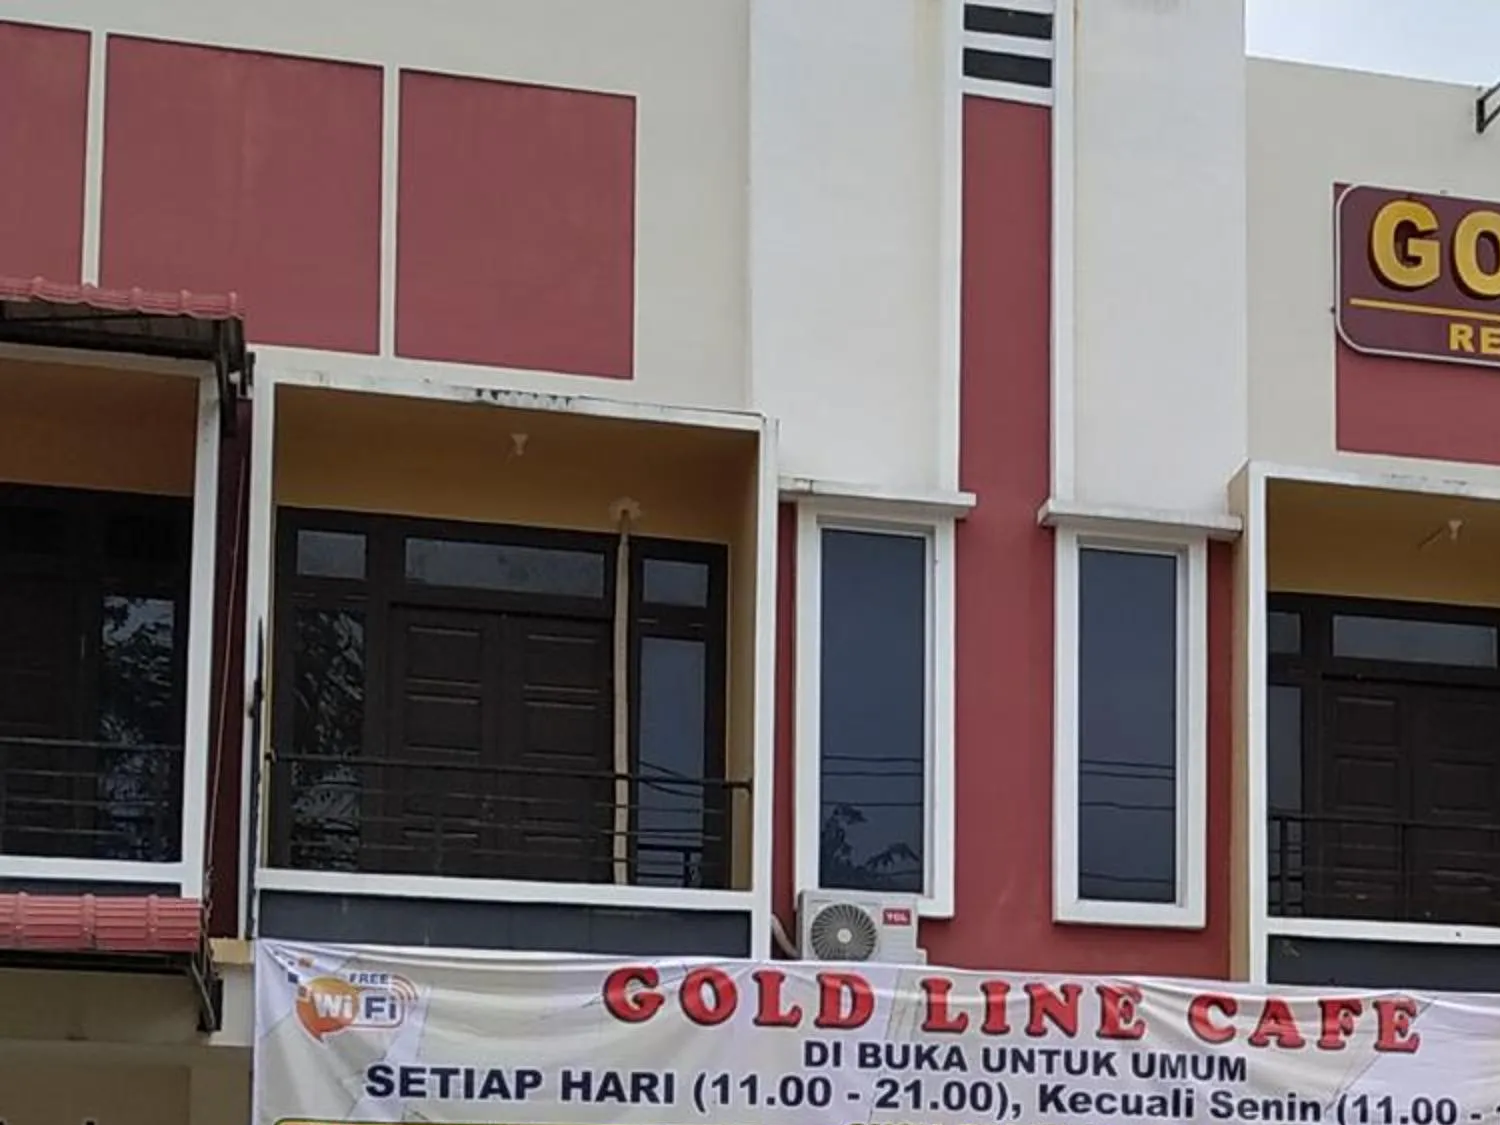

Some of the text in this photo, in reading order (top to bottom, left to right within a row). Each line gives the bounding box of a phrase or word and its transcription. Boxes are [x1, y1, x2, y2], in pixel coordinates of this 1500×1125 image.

[349, 972, 388, 984] FREE
[602, 966, 1421, 1054] GOLD LINE CAFE
[805, 1041, 1247, 1082] DI BUKA UNTUK UMUM
[366, 1064, 542, 1100] SETIAP
[561, 1070, 675, 1105] HARI
[693, 1072, 832, 1113] (11.00
[874, 1077, 1022, 1120] 21.00),
[1038, 1083, 1195, 1119] Kecuali
[1209, 1089, 1322, 1124] Senin
